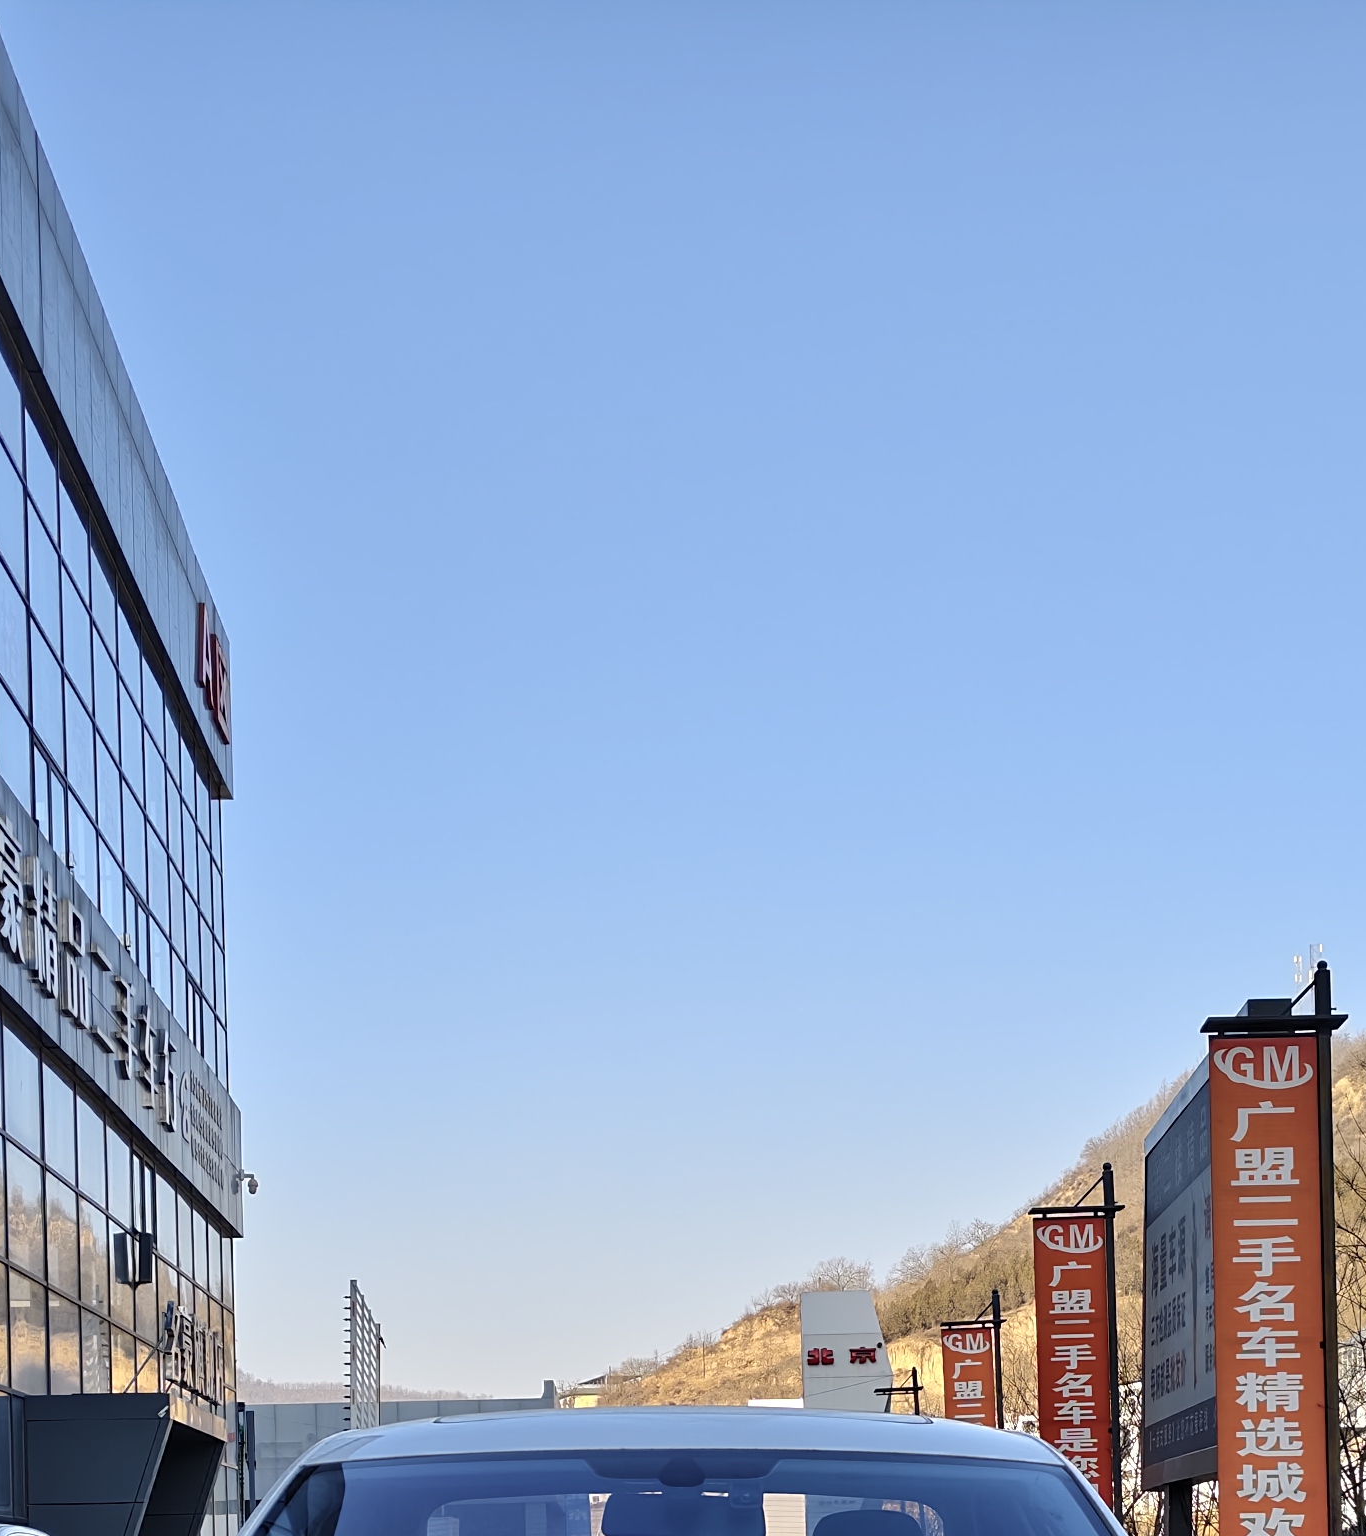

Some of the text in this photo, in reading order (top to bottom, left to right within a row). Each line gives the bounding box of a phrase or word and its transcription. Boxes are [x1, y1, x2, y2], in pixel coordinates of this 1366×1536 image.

[1223, 1046, 1301, 1084] GM
[1044, 1224, 1096, 1251] GM
[947, 1333, 986, 1351] GM
[807, 1346, 877, 1366] 北京
[951, 1359, 986, 1425] 广盟二
